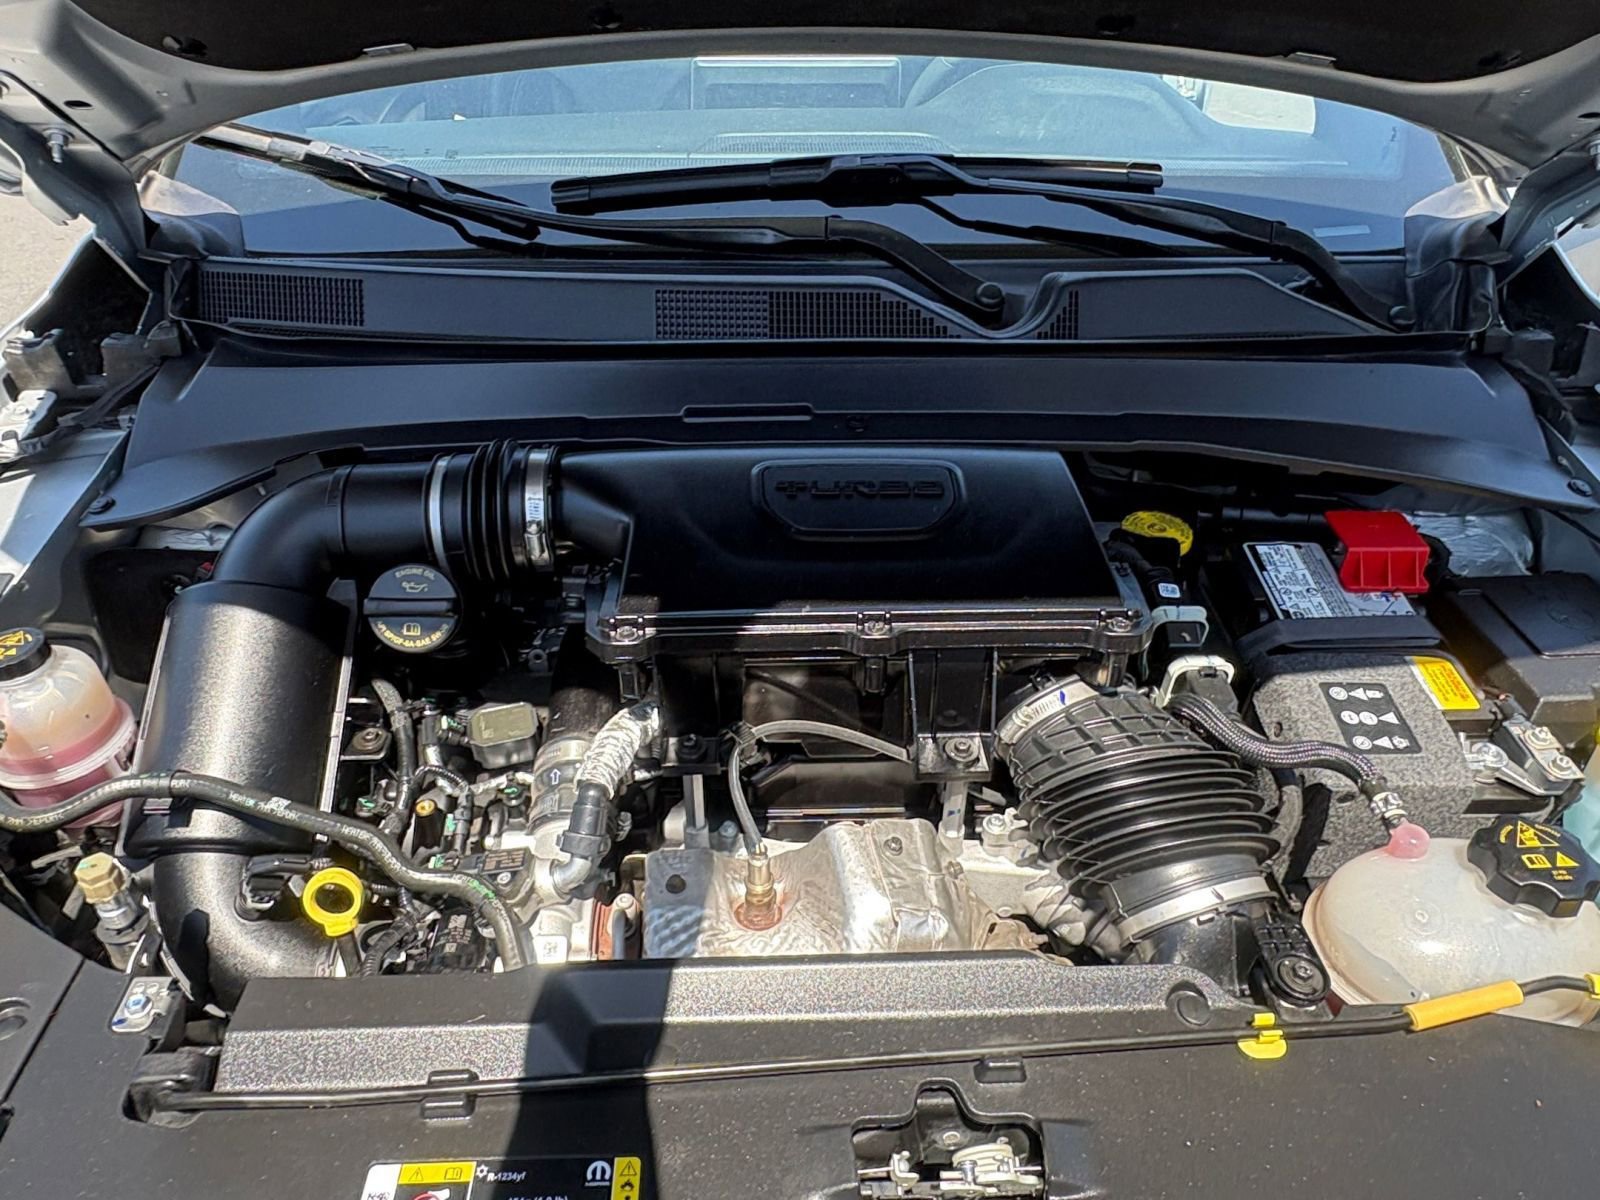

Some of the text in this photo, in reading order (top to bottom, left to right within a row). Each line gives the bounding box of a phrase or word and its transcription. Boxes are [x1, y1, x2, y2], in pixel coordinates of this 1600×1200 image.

[394, 568, 436, 580] ENGINE OIL
[486, 1172, 527, 1183] R-1234yf
